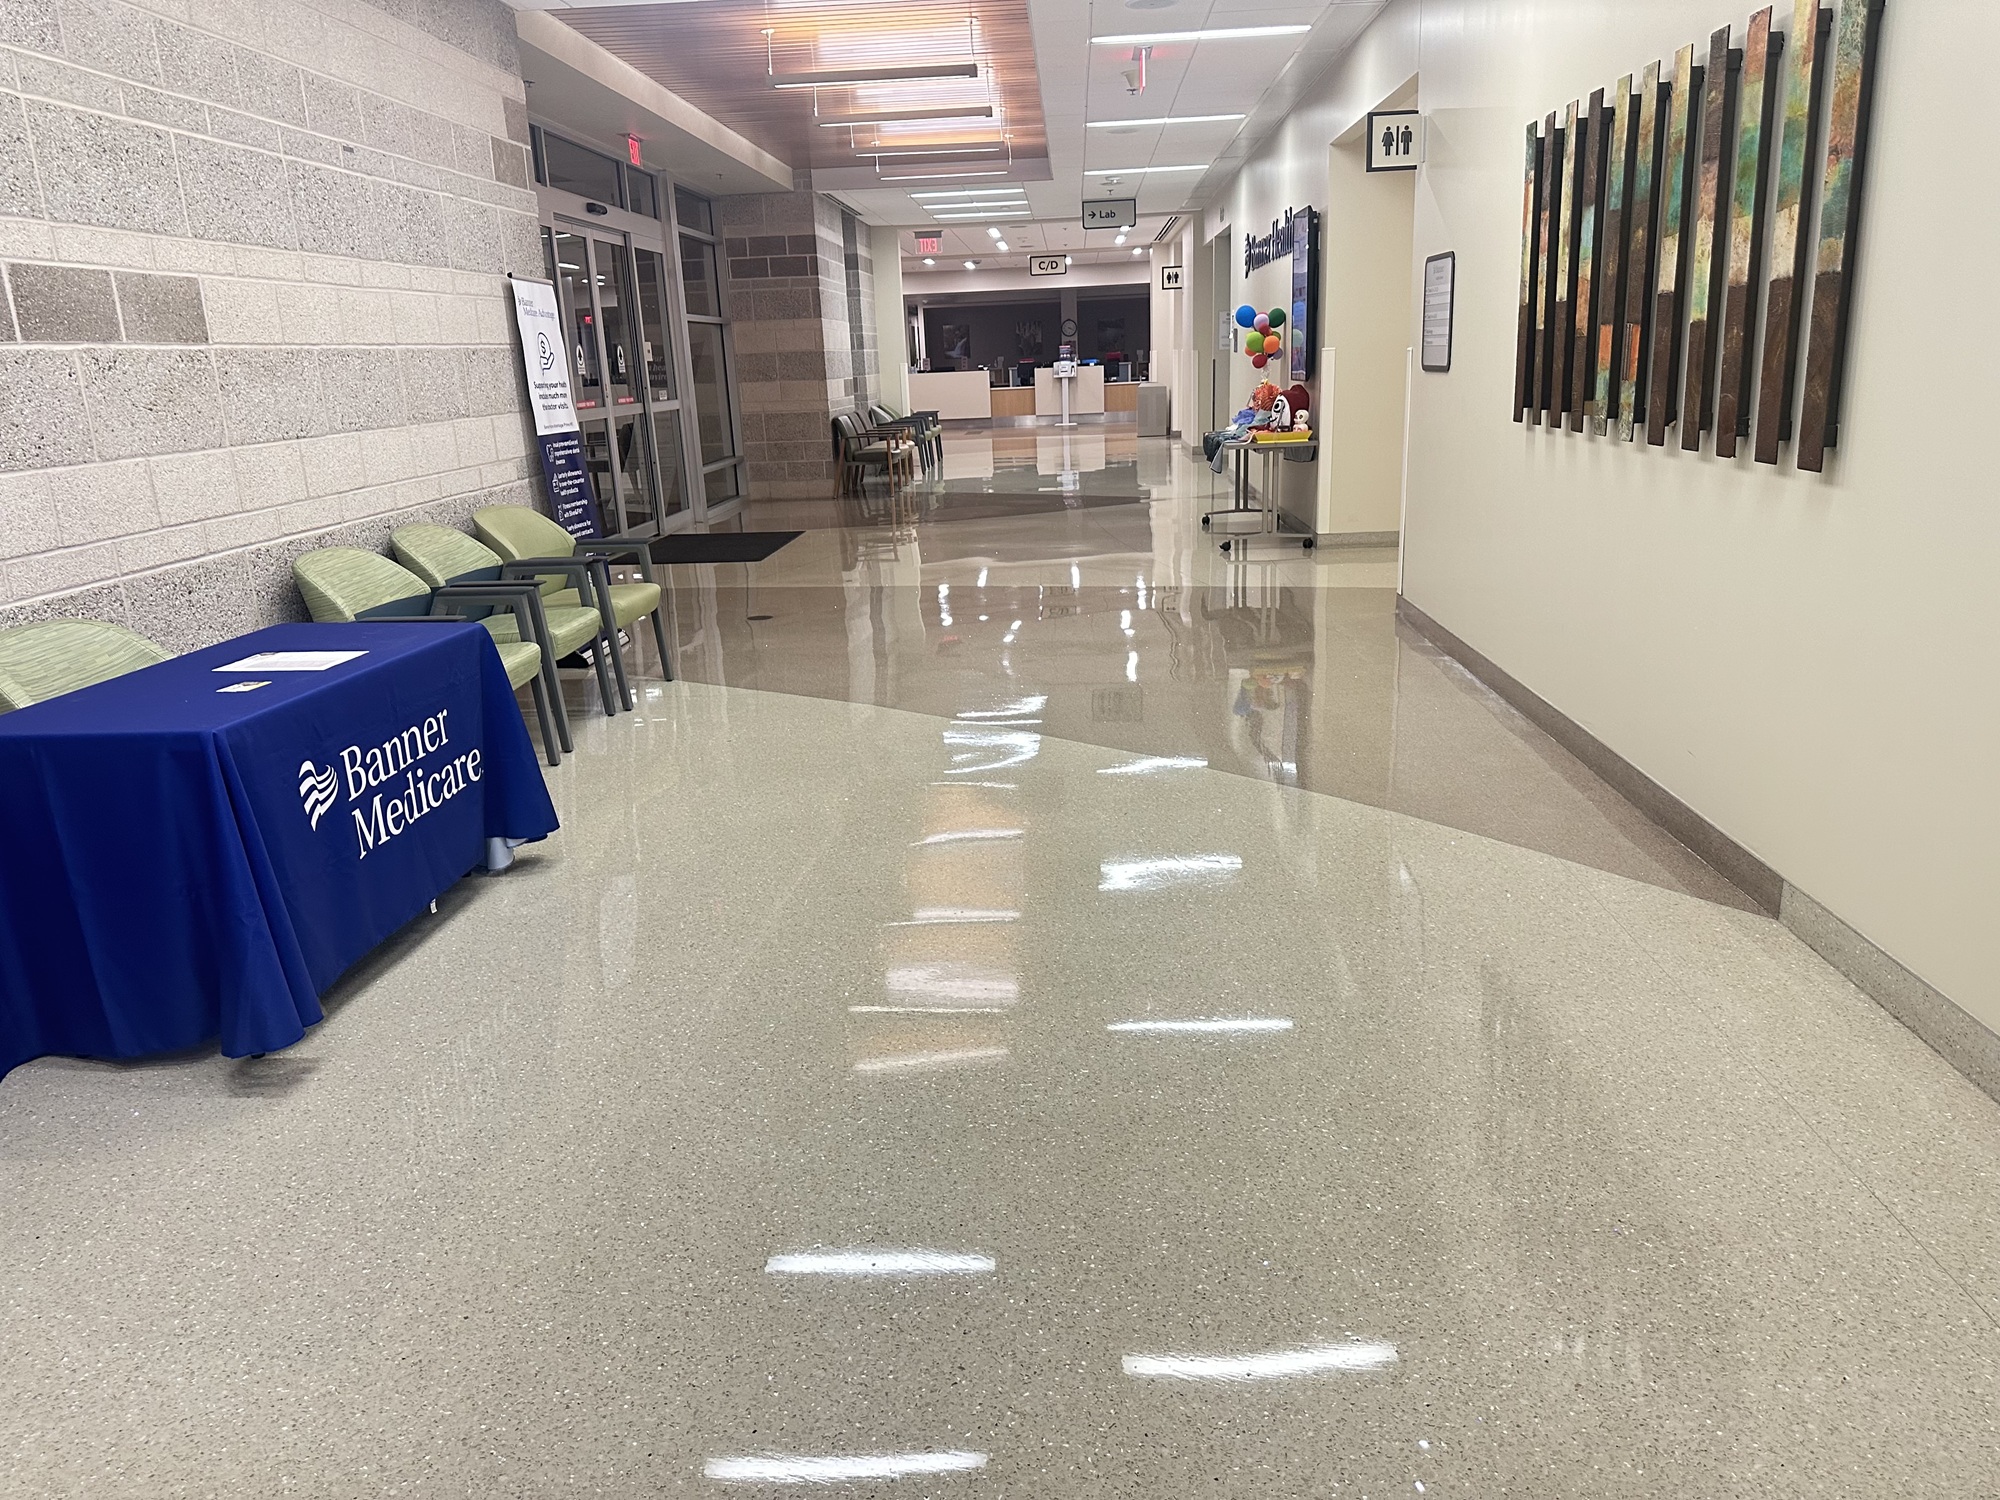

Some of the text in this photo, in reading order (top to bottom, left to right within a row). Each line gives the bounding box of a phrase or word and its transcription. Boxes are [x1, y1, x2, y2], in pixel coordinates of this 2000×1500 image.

[1099, 210, 1116, 219] Lab
[1038, 260, 1059, 272] C/D
[339, 708, 448, 802] Banner
[351, 748, 483, 860] Medicare
